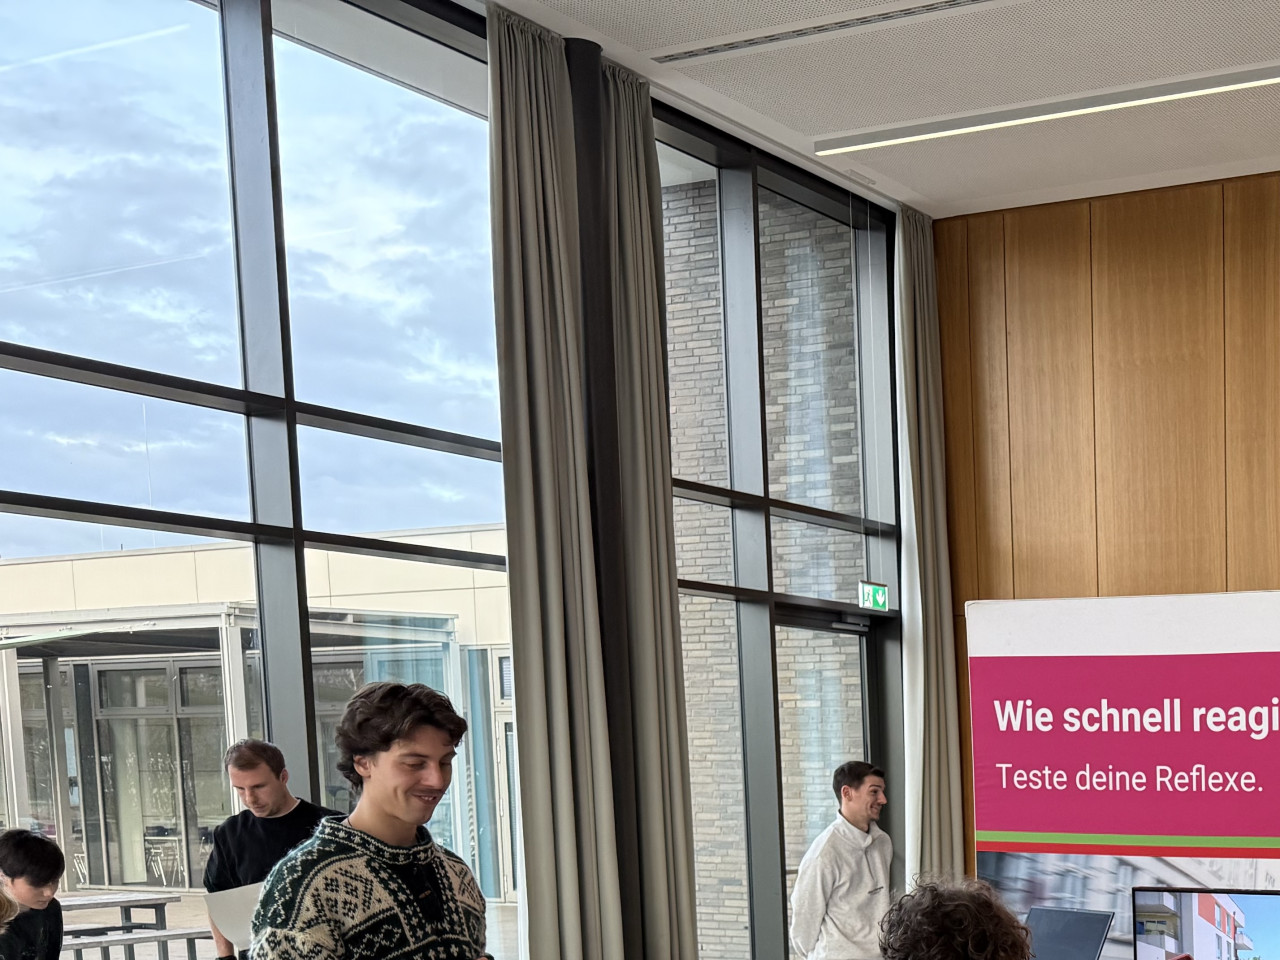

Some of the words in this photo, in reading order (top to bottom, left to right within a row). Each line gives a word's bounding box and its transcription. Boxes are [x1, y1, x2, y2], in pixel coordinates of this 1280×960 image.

[993, 699, 1054, 732] Wie
[1063, 698, 1182, 733] schnell
[995, 763, 1068, 790] Teste
[1075, 763, 1147, 791] deine
[1156, 763, 1264, 793] Reflexe.
